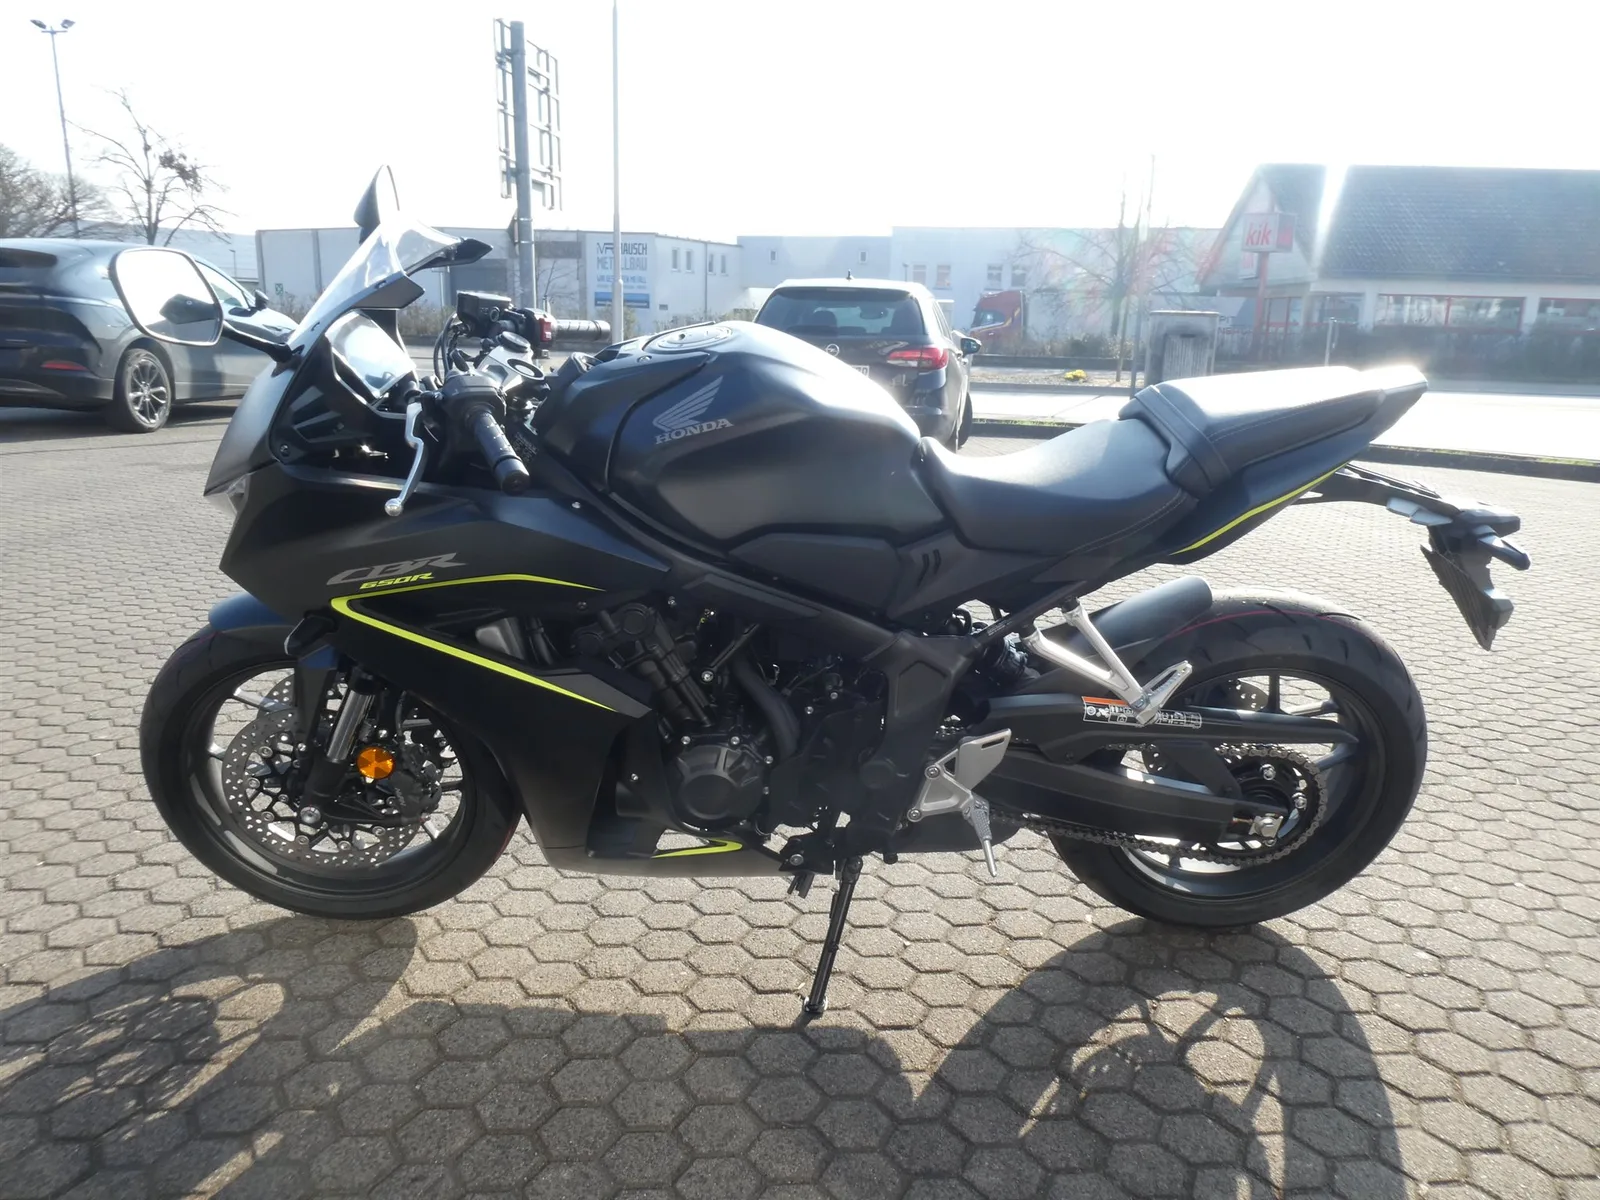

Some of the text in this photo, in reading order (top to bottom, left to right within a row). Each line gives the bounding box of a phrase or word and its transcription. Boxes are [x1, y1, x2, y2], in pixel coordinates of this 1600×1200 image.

[1246, 222, 1271, 246] kik
[654, 418, 734, 444] HONDA
[326, 552, 467, 585] CBR
[360, 572, 434, 589] 650R
